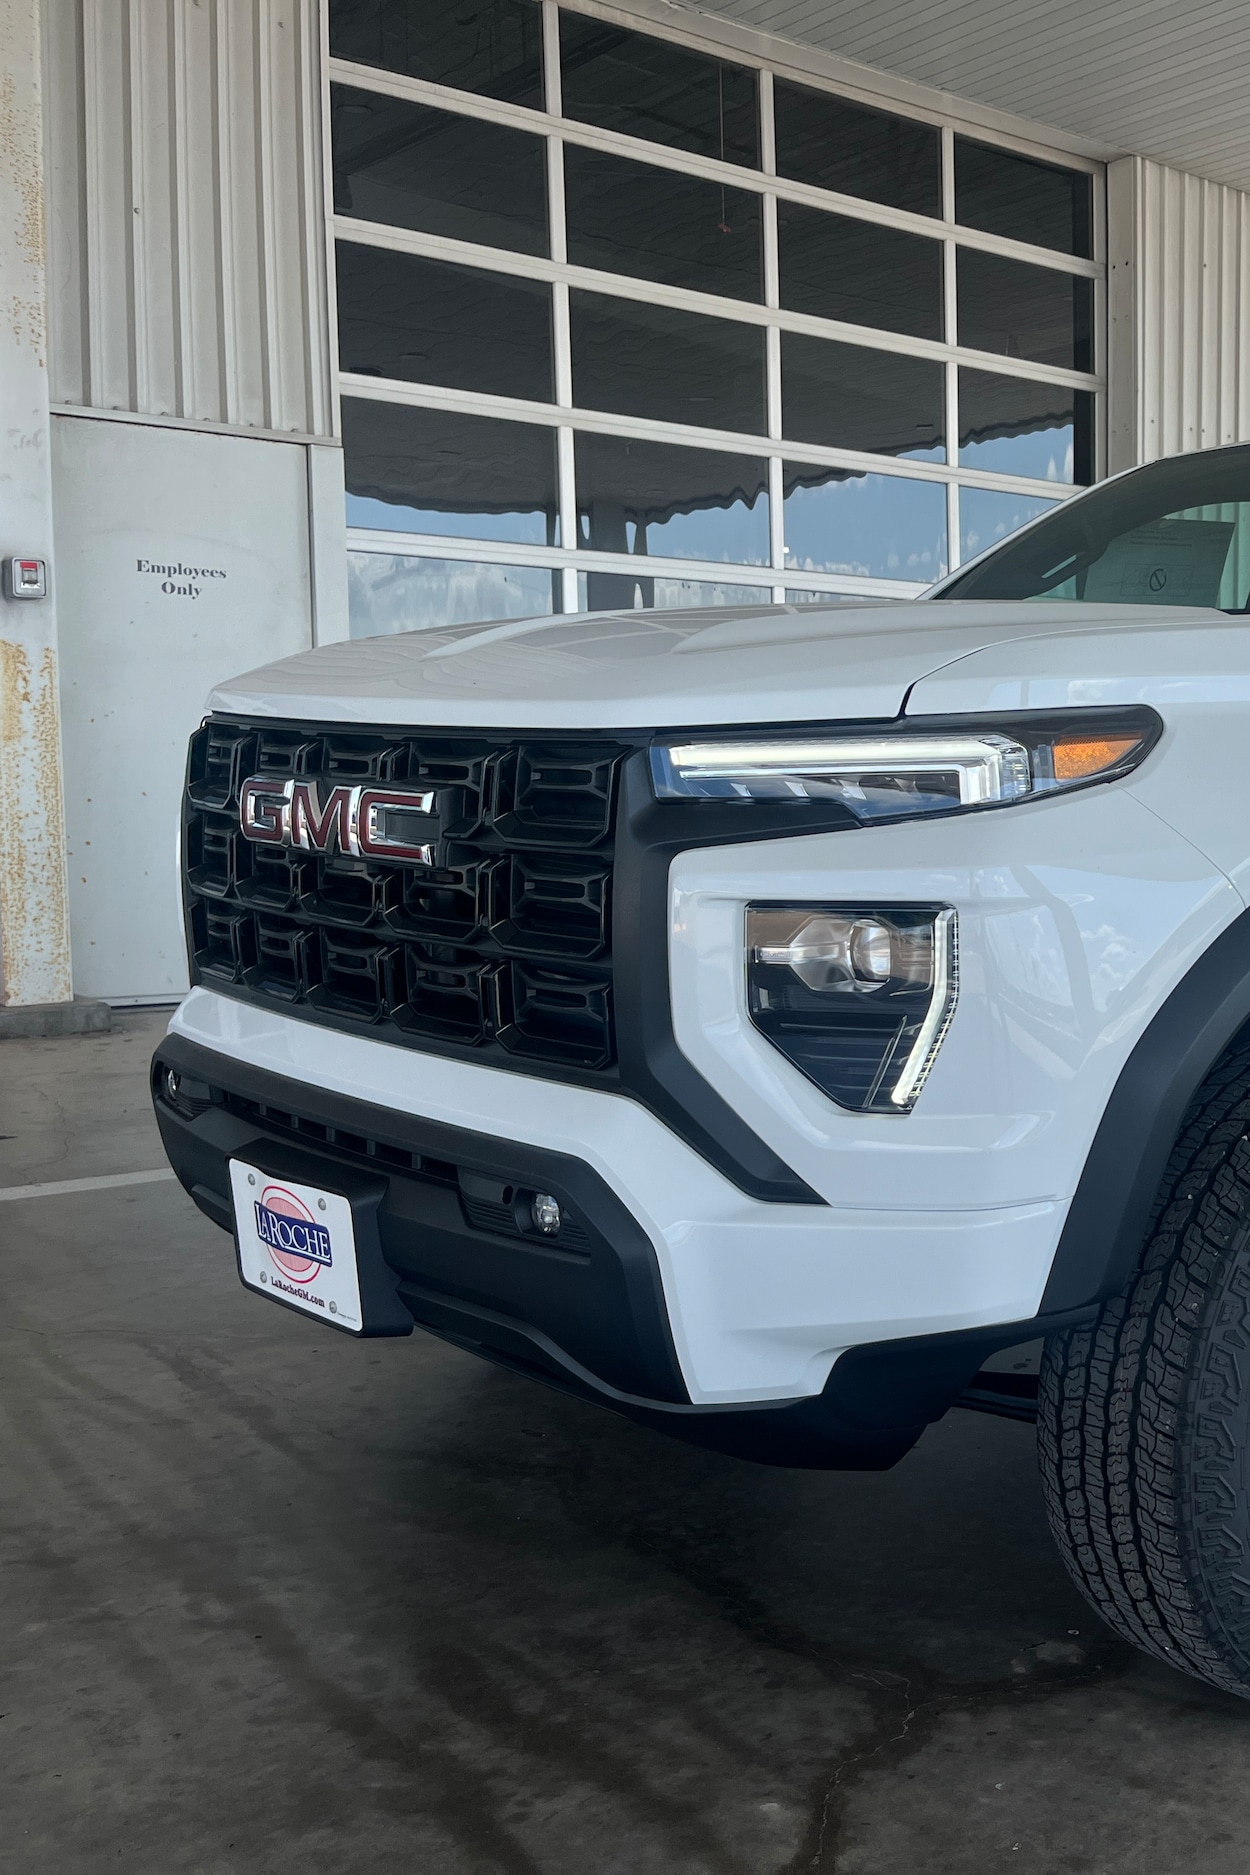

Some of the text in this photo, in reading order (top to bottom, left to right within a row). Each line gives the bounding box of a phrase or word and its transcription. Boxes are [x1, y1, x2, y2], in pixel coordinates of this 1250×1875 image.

[136, 559, 227, 579] Employees
[161, 581, 202, 600] Only
[240, 777, 436, 867] GMC
[254, 1203, 331, 1259] LAROCHE
[271, 1276, 325, 1308] LaRocheGM.com
